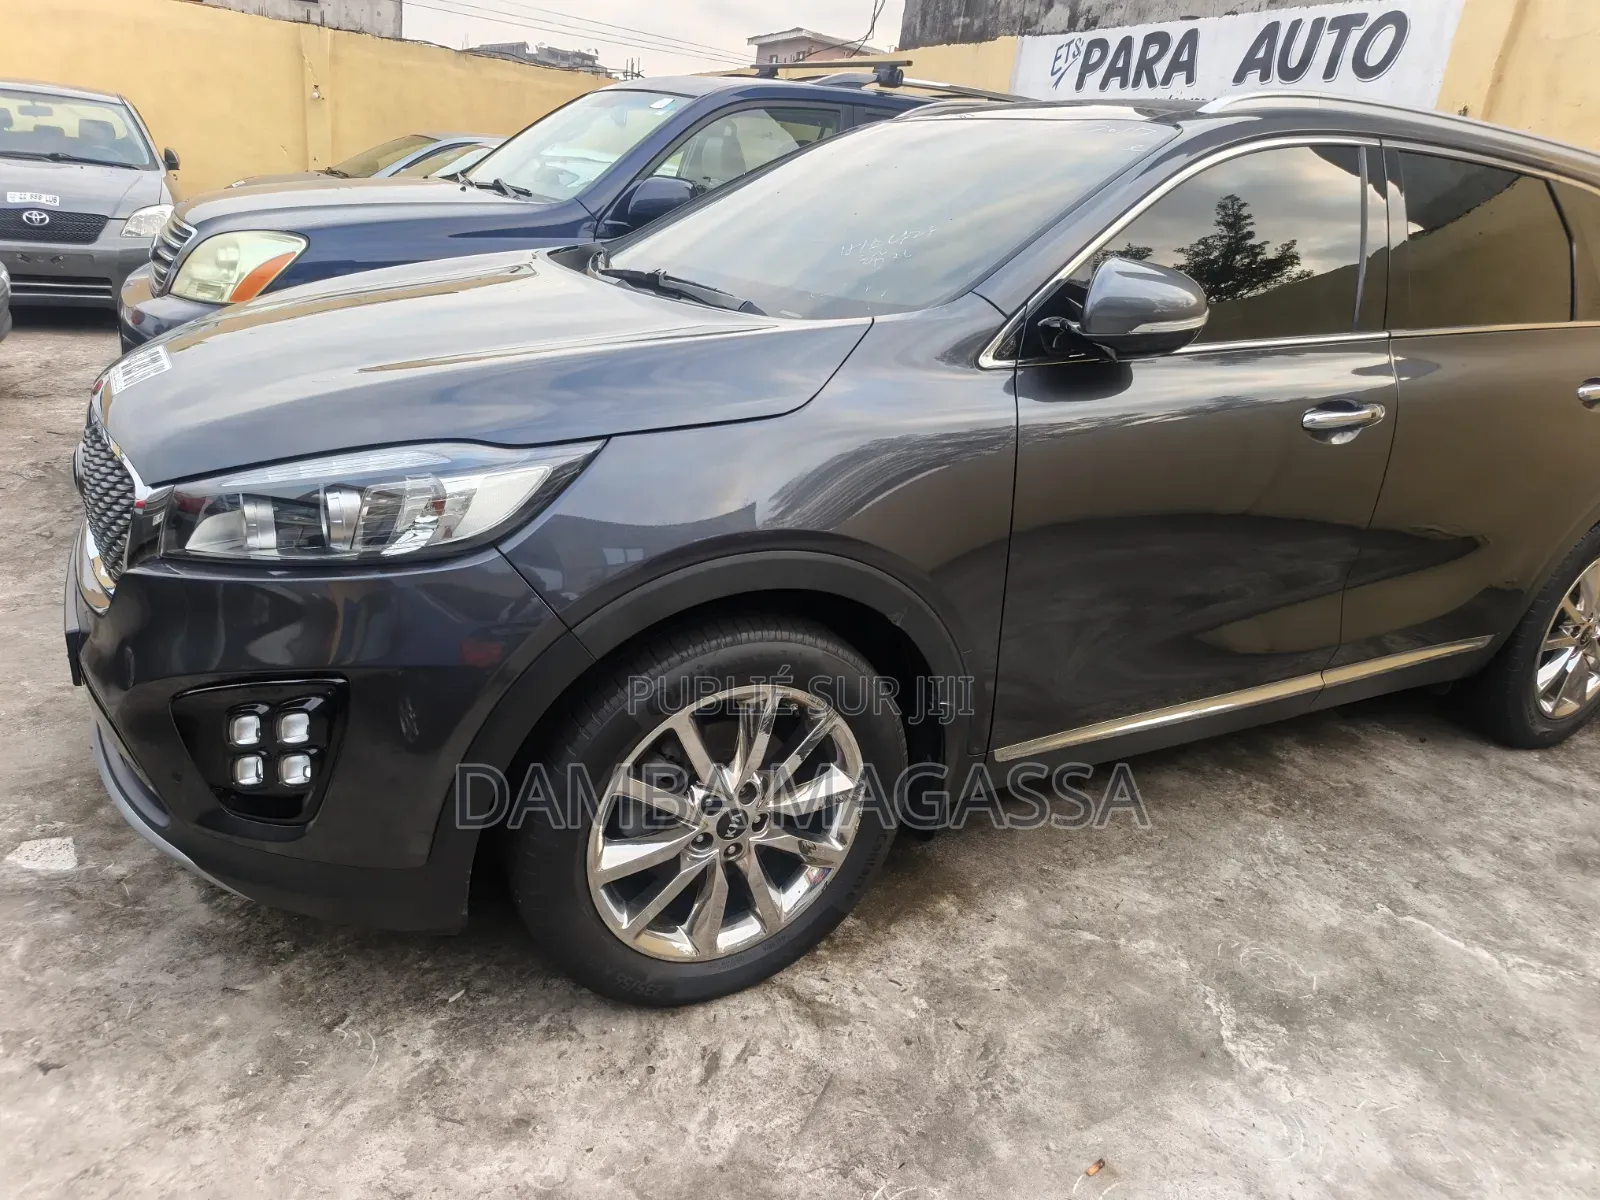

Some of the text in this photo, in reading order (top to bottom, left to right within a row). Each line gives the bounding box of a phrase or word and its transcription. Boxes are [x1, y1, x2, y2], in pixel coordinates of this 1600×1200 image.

[1075, 27, 1199, 92] PARA
[1231, 9, 1411, 87] AUTO
[724, 811, 743, 838] KIA
